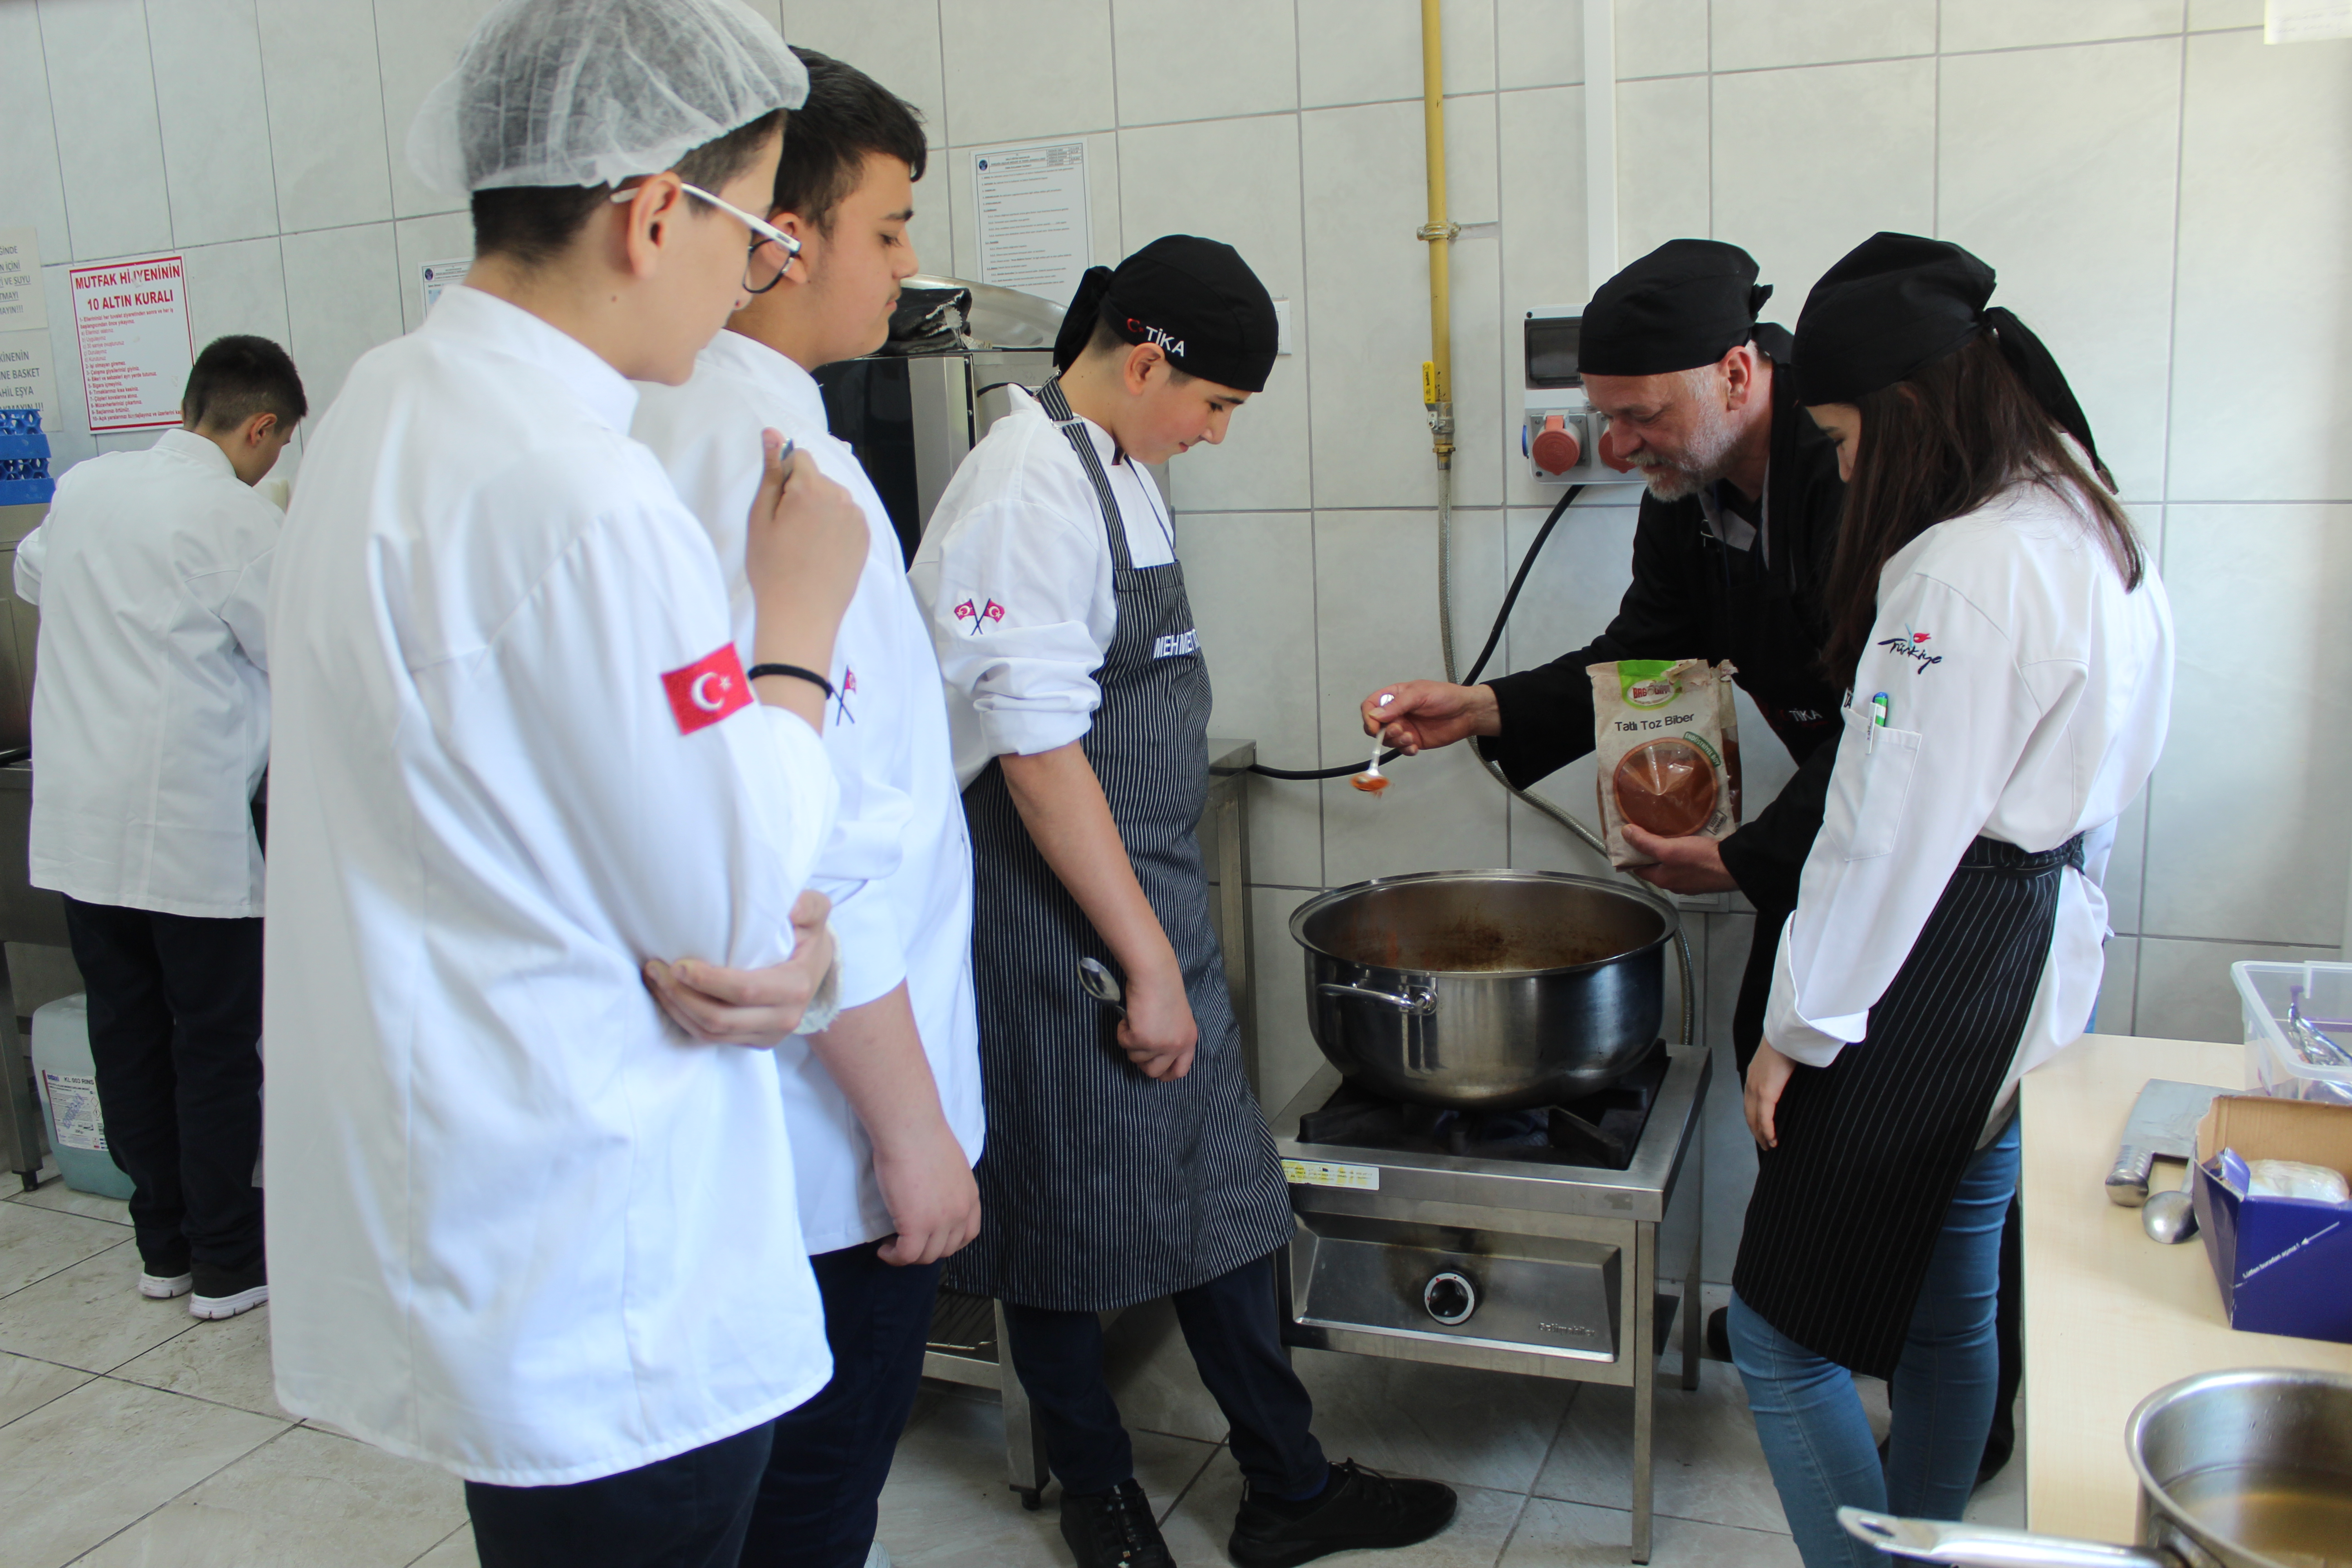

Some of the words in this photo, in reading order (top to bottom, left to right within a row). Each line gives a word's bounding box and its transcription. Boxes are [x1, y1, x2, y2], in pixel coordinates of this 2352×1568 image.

[4, 277, 13, 285] VE
[14, 275, 30, 285] SUYU
[75, 273, 118, 289] MUTFAK
[88, 298, 99, 311] 10
[103, 294, 132, 309] ALTIN
[135, 289, 173, 305] KURALI
[1146, 326, 1184, 357] TİKA
[12, 368, 40, 379] BASKET
[15, 386, 34, 398] EŞYA
[1877, 637, 1942, 675] Türkiye
[1615, 721, 1638, 731] Tatlı
[1640, 719, 1662, 730] Toz
[1665, 713, 1695, 726] Biber
[1789, 708, 1823, 722] TİKA
[1685, 732, 1713, 756] ENDÜSTRİYEL
[1710, 754, 1720, 765] BOY
